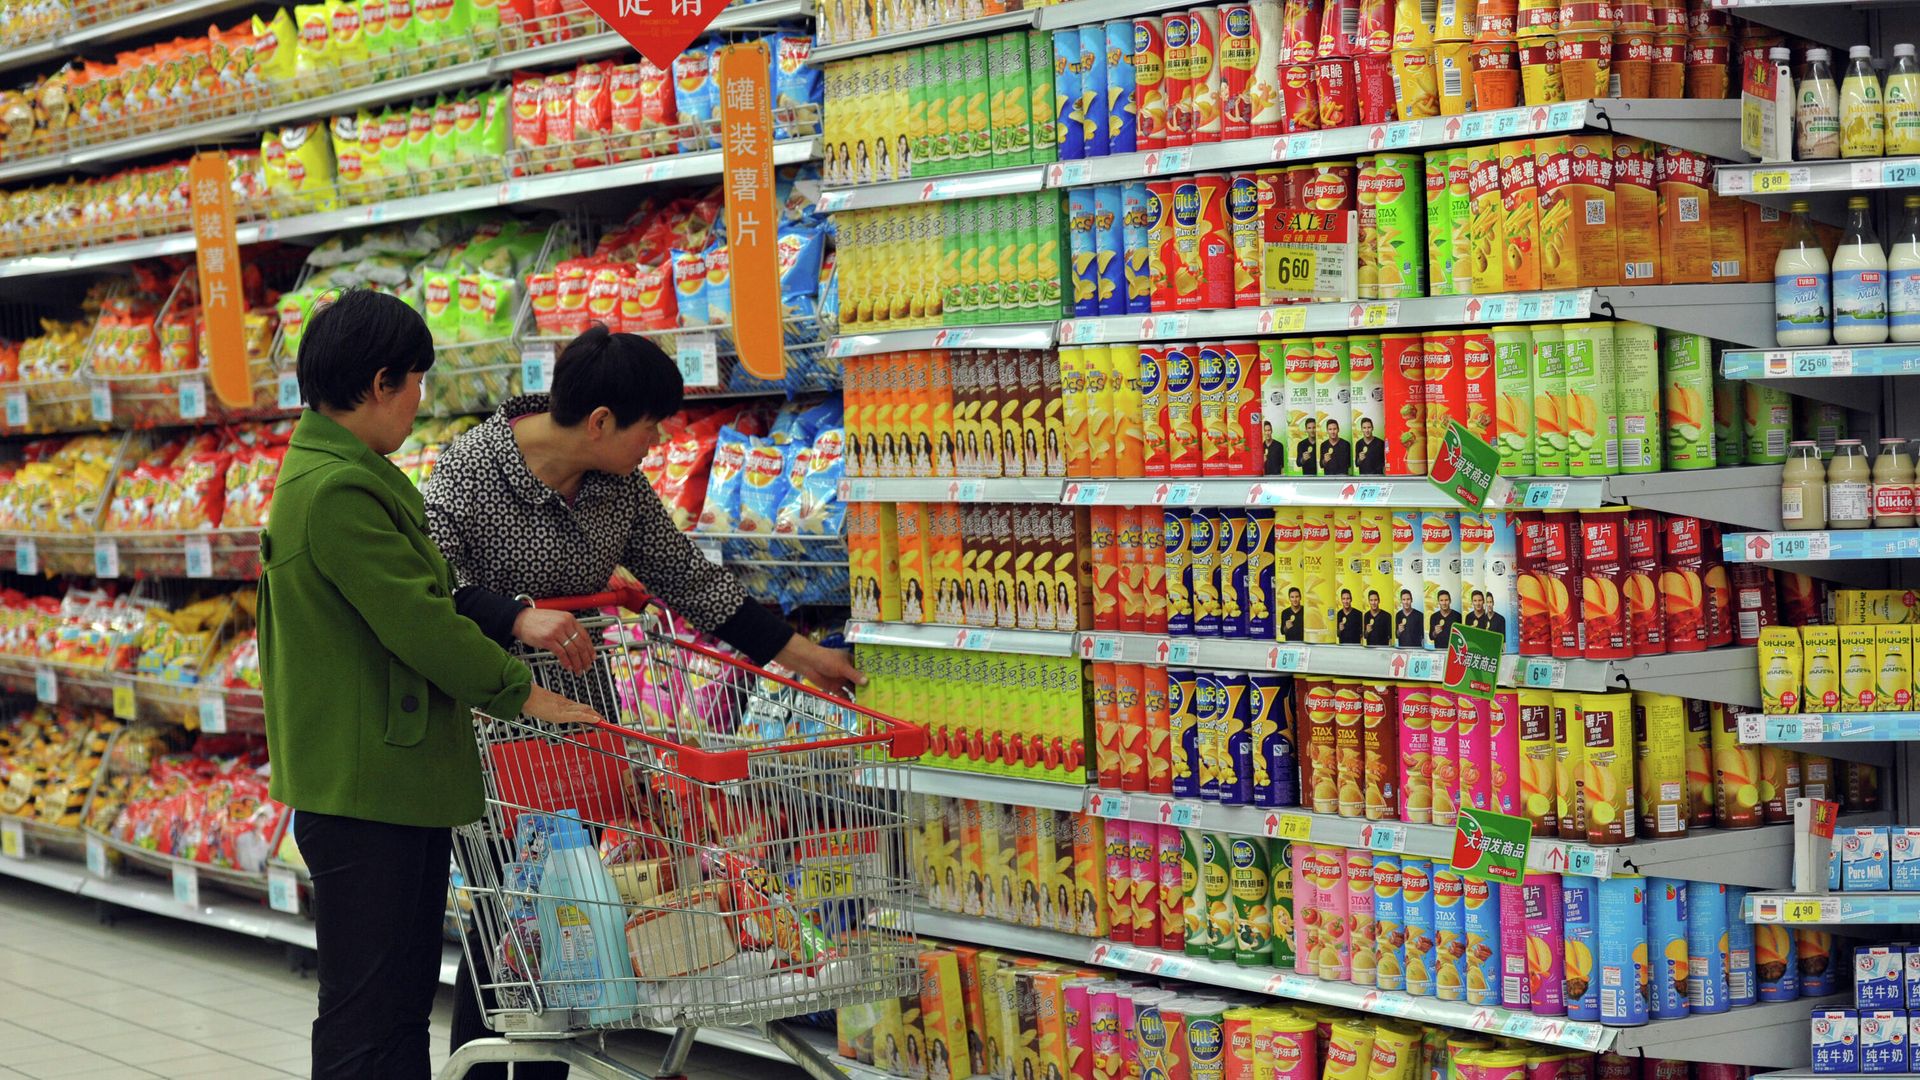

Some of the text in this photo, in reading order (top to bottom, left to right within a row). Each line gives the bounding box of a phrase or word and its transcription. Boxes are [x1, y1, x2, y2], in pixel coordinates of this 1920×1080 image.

[1320, 64, 1343, 80] 真脆
[1499, 118, 1513, 132] 520
[1553, 110, 1568, 126] 520
[1466, 122, 1480, 136] 520
[726, 77, 760, 247] 罐装薯片
[1666, 158, 1708, 179] 妙脆薯
[1501, 160, 1534, 189] 妙脆薯
[1537, 159, 1570, 187] 妙脆薯
[1572, 161, 1612, 179] 妙脆薯
[1615, 161, 1653, 179] 妙脆薯
[1888, 169, 1916, 183] 1270
[1469, 165, 1498, 193] 妙脆薯
[1761, 176, 1782, 189] 880
[1378, 208, 1397, 217] STAX
[1273, 211, 1338, 231] SALE
[1278, 257, 1309, 285] 660
[1862, 273, 1880, 283] TURM
[1798, 278, 1816, 286] TURM
[1794, 290, 1818, 304] Milk
[1857, 287, 1881, 300] Milk
[1799, 358, 1827, 372] 2560
[1444, 450, 1491, 489] 大润发商品
[1532, 490, 1548, 503] 640
[1878, 495, 1913, 507] Bikkle
[1778, 541, 1804, 554] 1490
[1304, 556, 1322, 566] STAX
[1763, 640, 1795, 648] 바나나맛
[1805, 639, 1836, 647] 바나나맛
[1842, 638, 1874, 646] 바나나맛
[1878, 637, 1910, 646] 바나나맛
[1454, 651, 1498, 673] 大润发商品
[1533, 667, 1547, 679] 640
[1312, 726, 1332, 736] STAX
[1338, 729, 1357, 739] STAX
[1777, 723, 1797, 739] 700
[1411, 733, 1427, 744] 无限
[1464, 833, 1526, 859] 大润发商品
[1575, 856, 1590, 868] 640
[1848, 865, 1883, 880] Pure Milk
[1350, 896, 1371, 906] STAX
[1435, 910, 1456, 921] STAX
[1793, 907, 1813, 918] 490
[1862, 985, 1899, 999] 纯牛奶
[1190, 1026, 1219, 1047] 可比克
[1817, 1049, 1854, 1063] 纯牛奶
[1865, 1049, 1903, 1063] 纯牛奶
